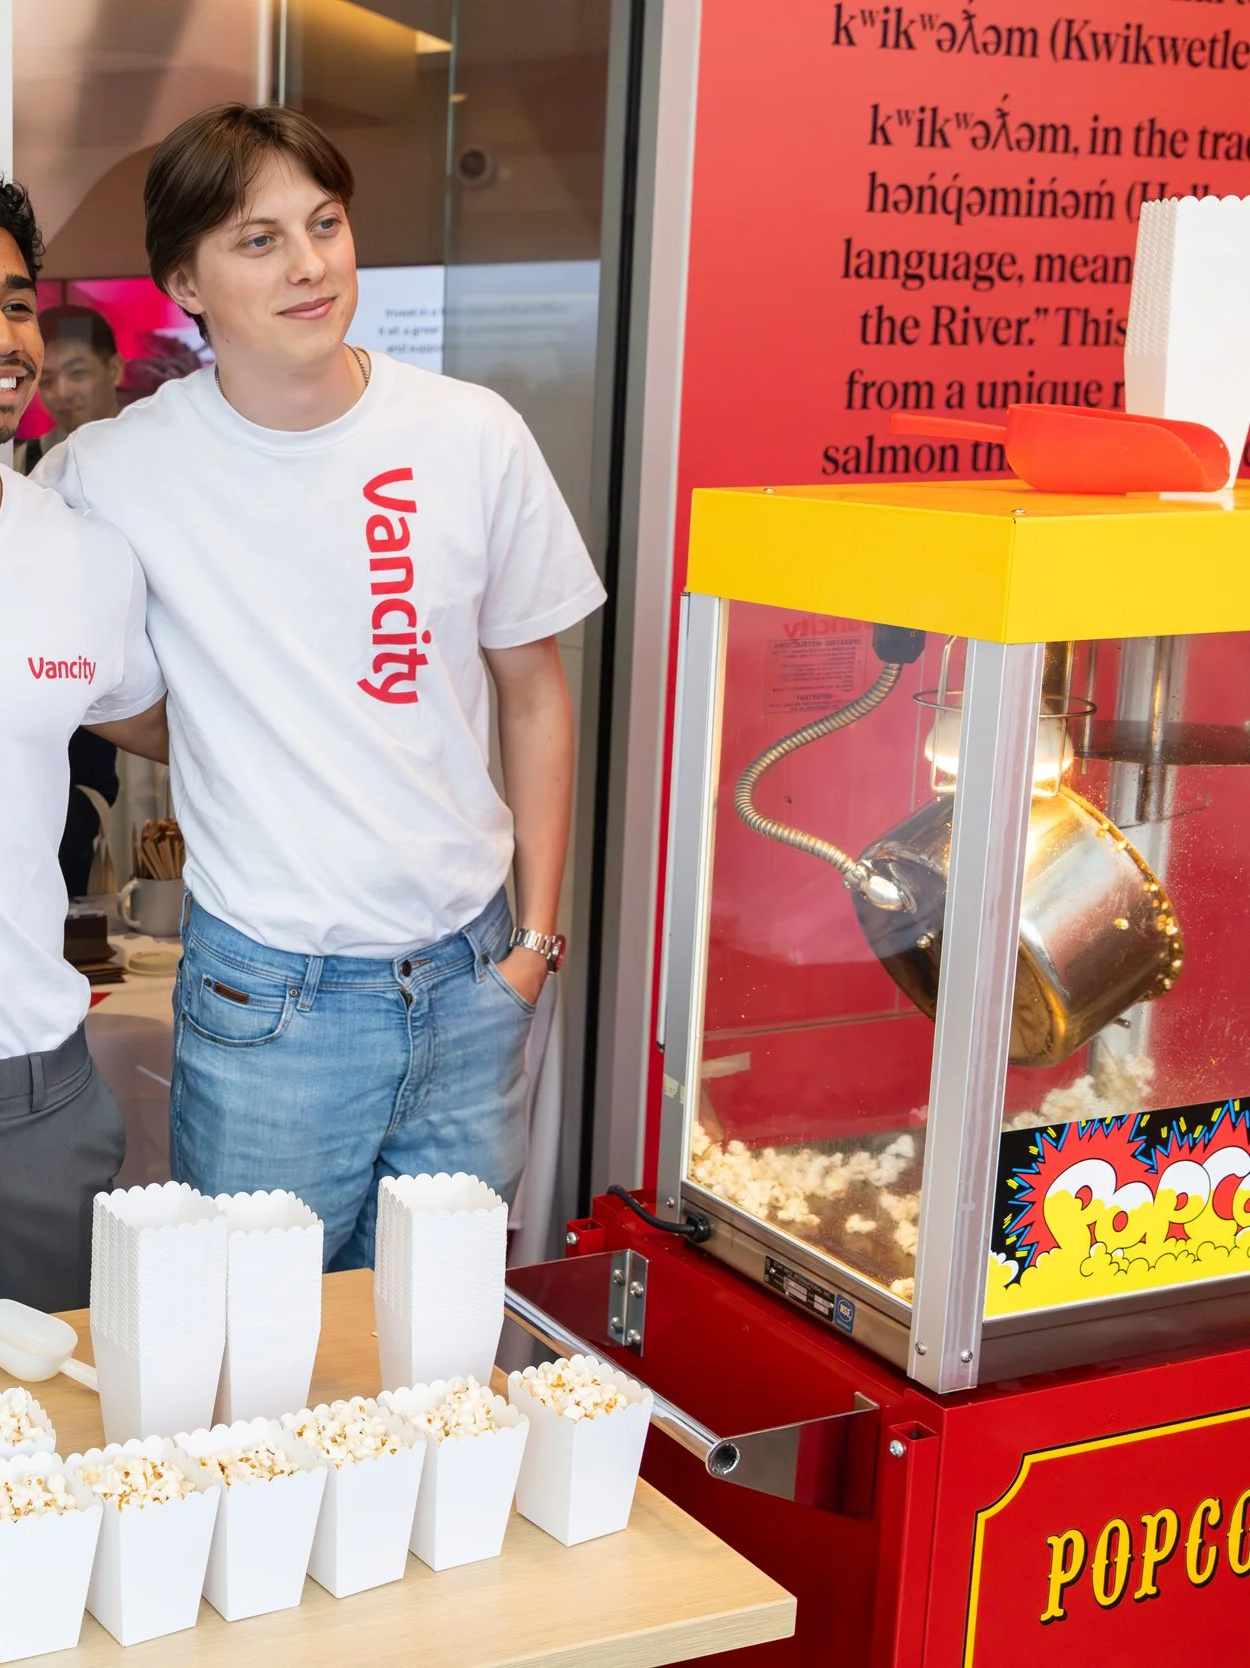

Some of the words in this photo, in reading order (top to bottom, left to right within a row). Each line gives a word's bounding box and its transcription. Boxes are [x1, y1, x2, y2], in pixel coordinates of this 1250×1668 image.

[1087, 114, 1122, 156] in
[1134, 118, 1189, 159] the
[1198, 125, 1250, 161] tra
[840, 238, 1024, 292] language,
[860, 304, 920, 346] the
[1055, 307, 1127, 347] This
[845, 368, 934, 410] from
[945, 379, 964, 409] a
[821, 434, 958, 476] salmon
[971, 440, 1012, 473] th
[357, 467, 432, 704] Vancity
[27, 655, 96, 686] Vancity
[1040, 1488, 1250, 1627] POPCO
